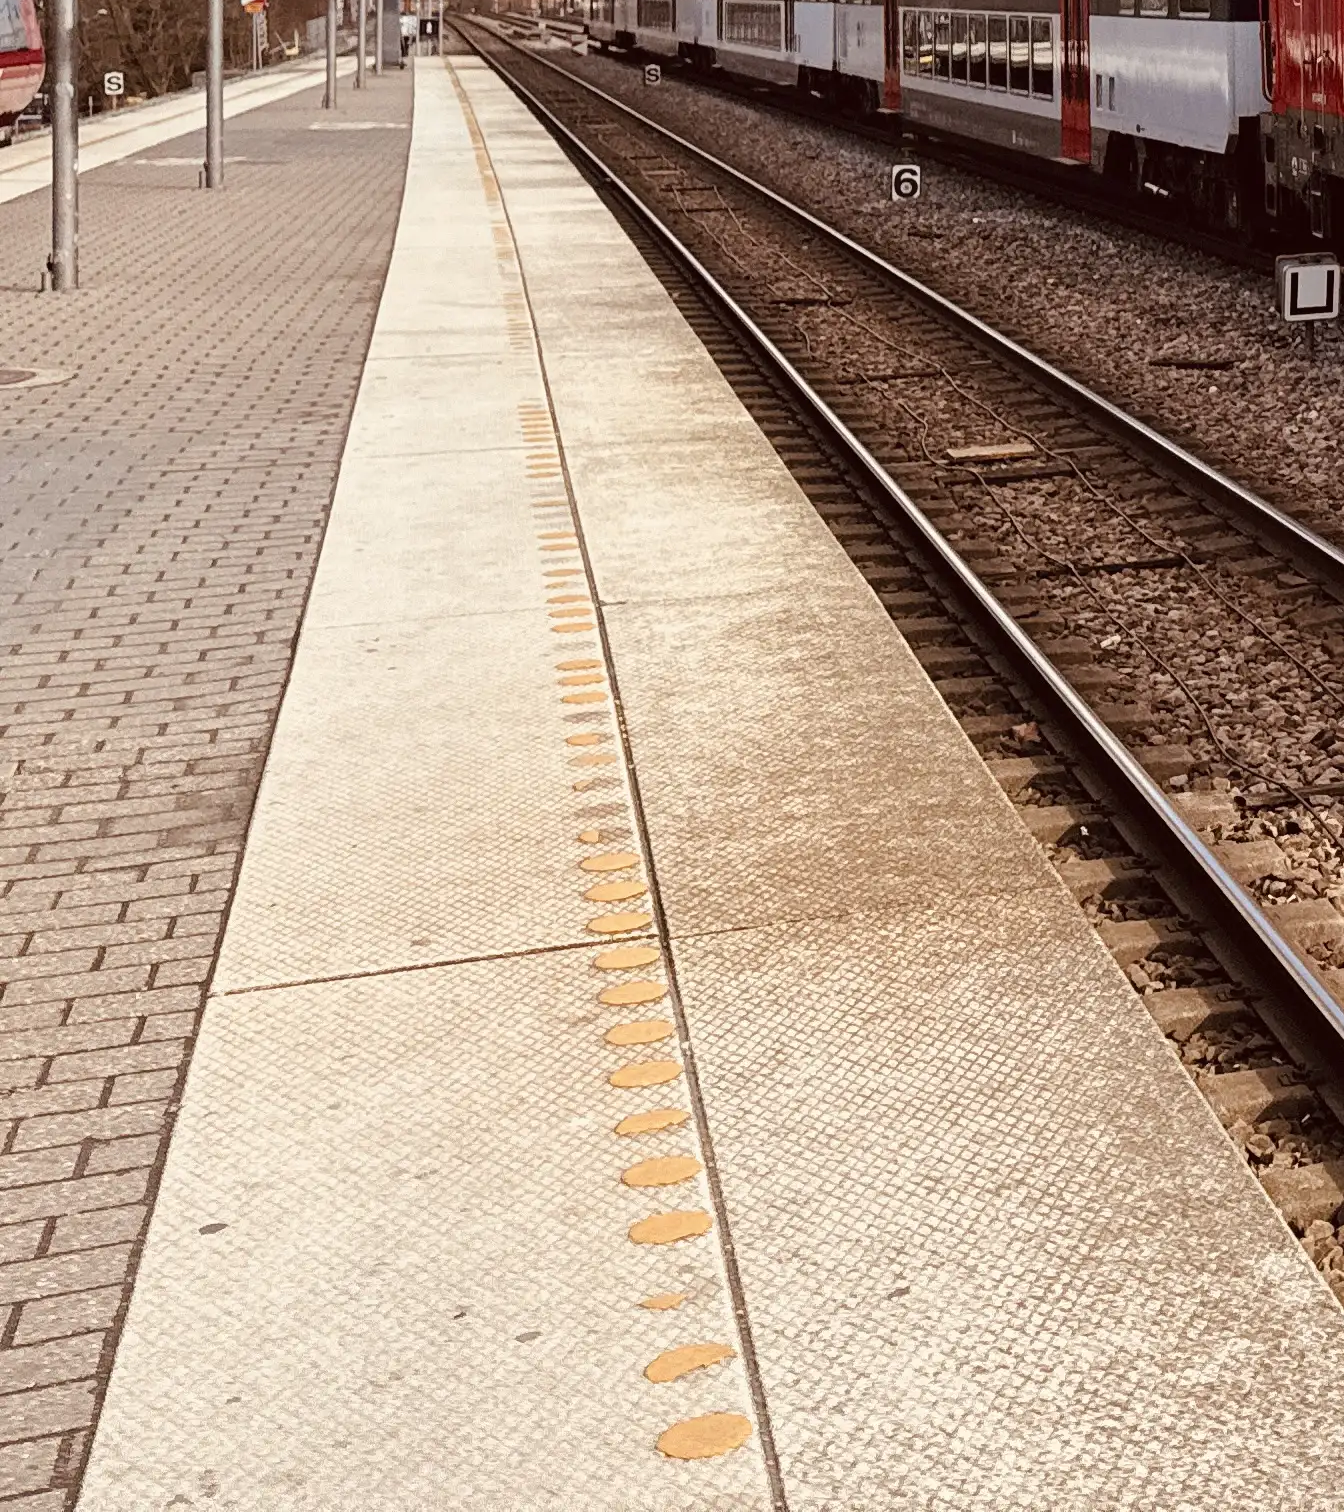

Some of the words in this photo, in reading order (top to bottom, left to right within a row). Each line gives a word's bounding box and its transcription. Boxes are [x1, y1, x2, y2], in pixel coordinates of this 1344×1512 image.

[647, 68, 660, 82] S
[107, 76, 121, 91] S
[894, 168, 918, 198] 6
